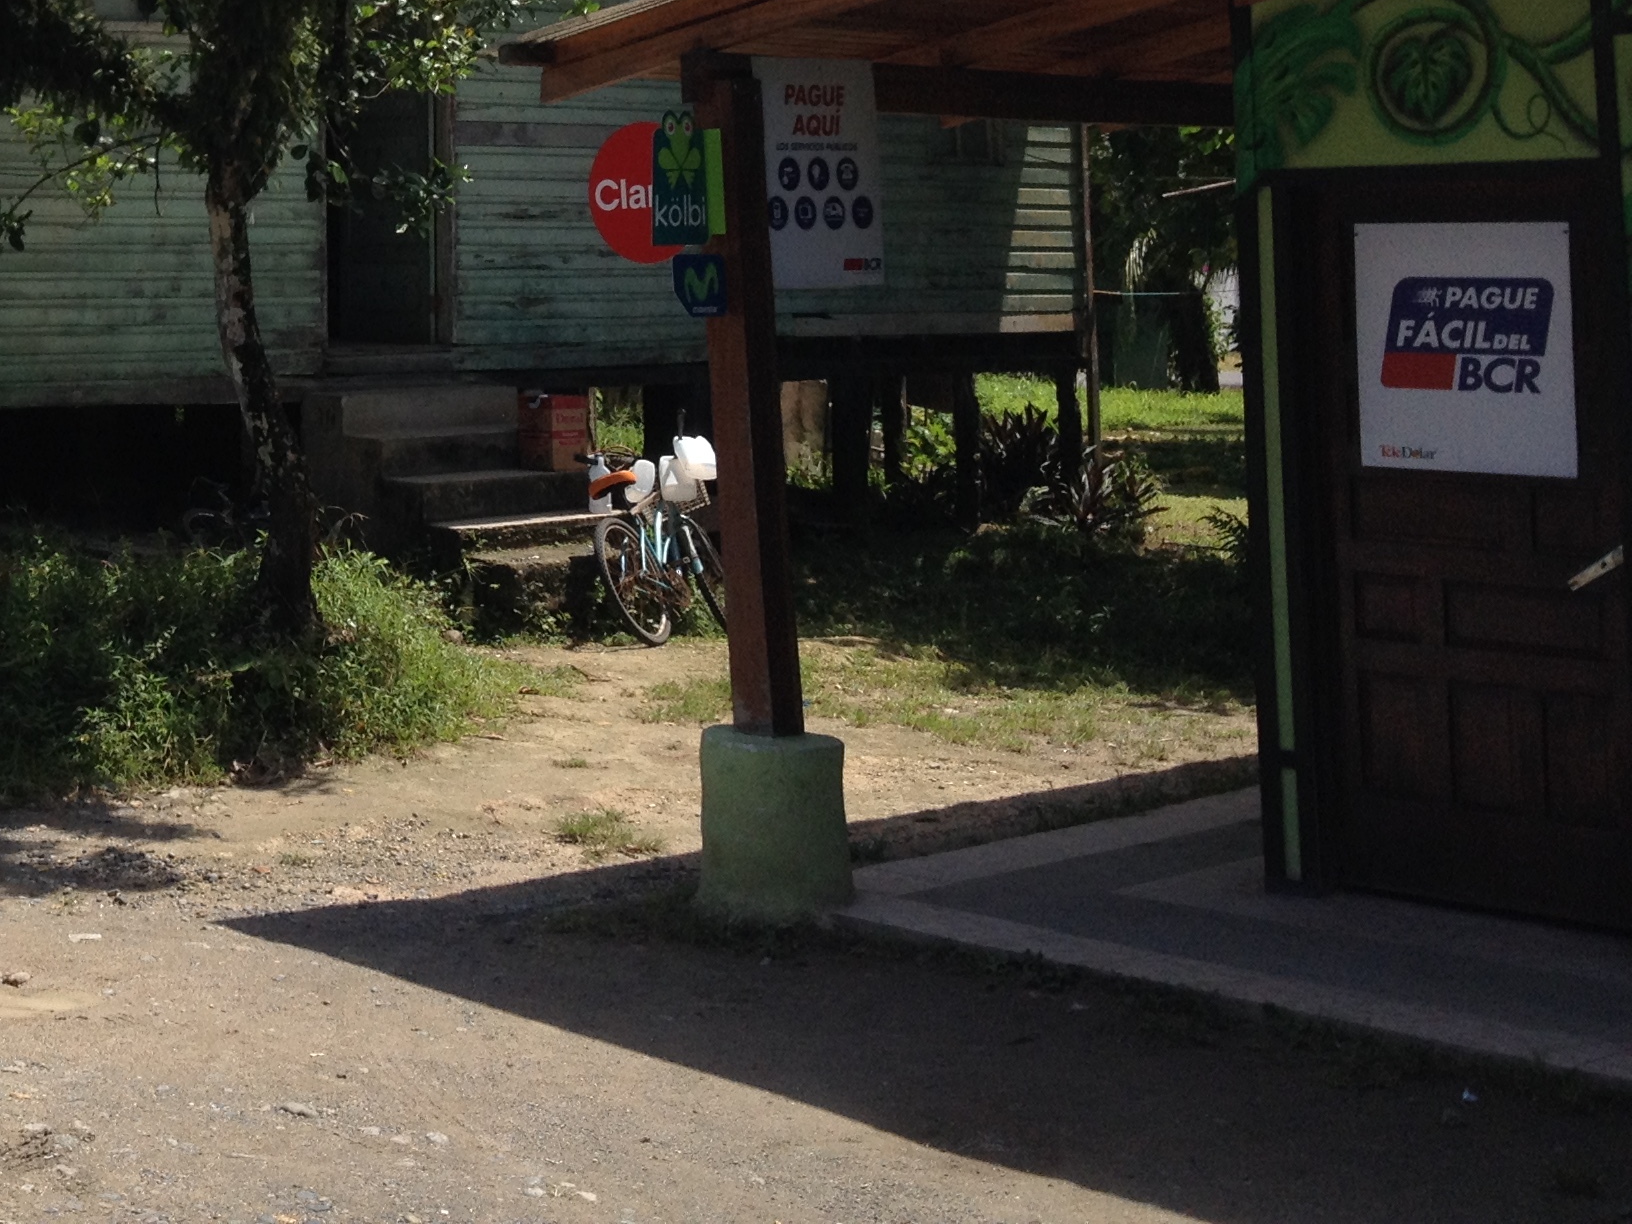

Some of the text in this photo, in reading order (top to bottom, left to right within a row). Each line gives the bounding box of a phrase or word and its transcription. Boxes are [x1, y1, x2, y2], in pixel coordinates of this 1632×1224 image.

[784, 84, 845, 107] PAGUE
[792, 109, 841, 137] AQUÍ
[654, 193, 707, 227] kölbi
[1444, 286, 1540, 310] PAGUE
[1395, 312, 1531, 351] FÁCIL DEL
[1457, 356, 1542, 394] BCR
